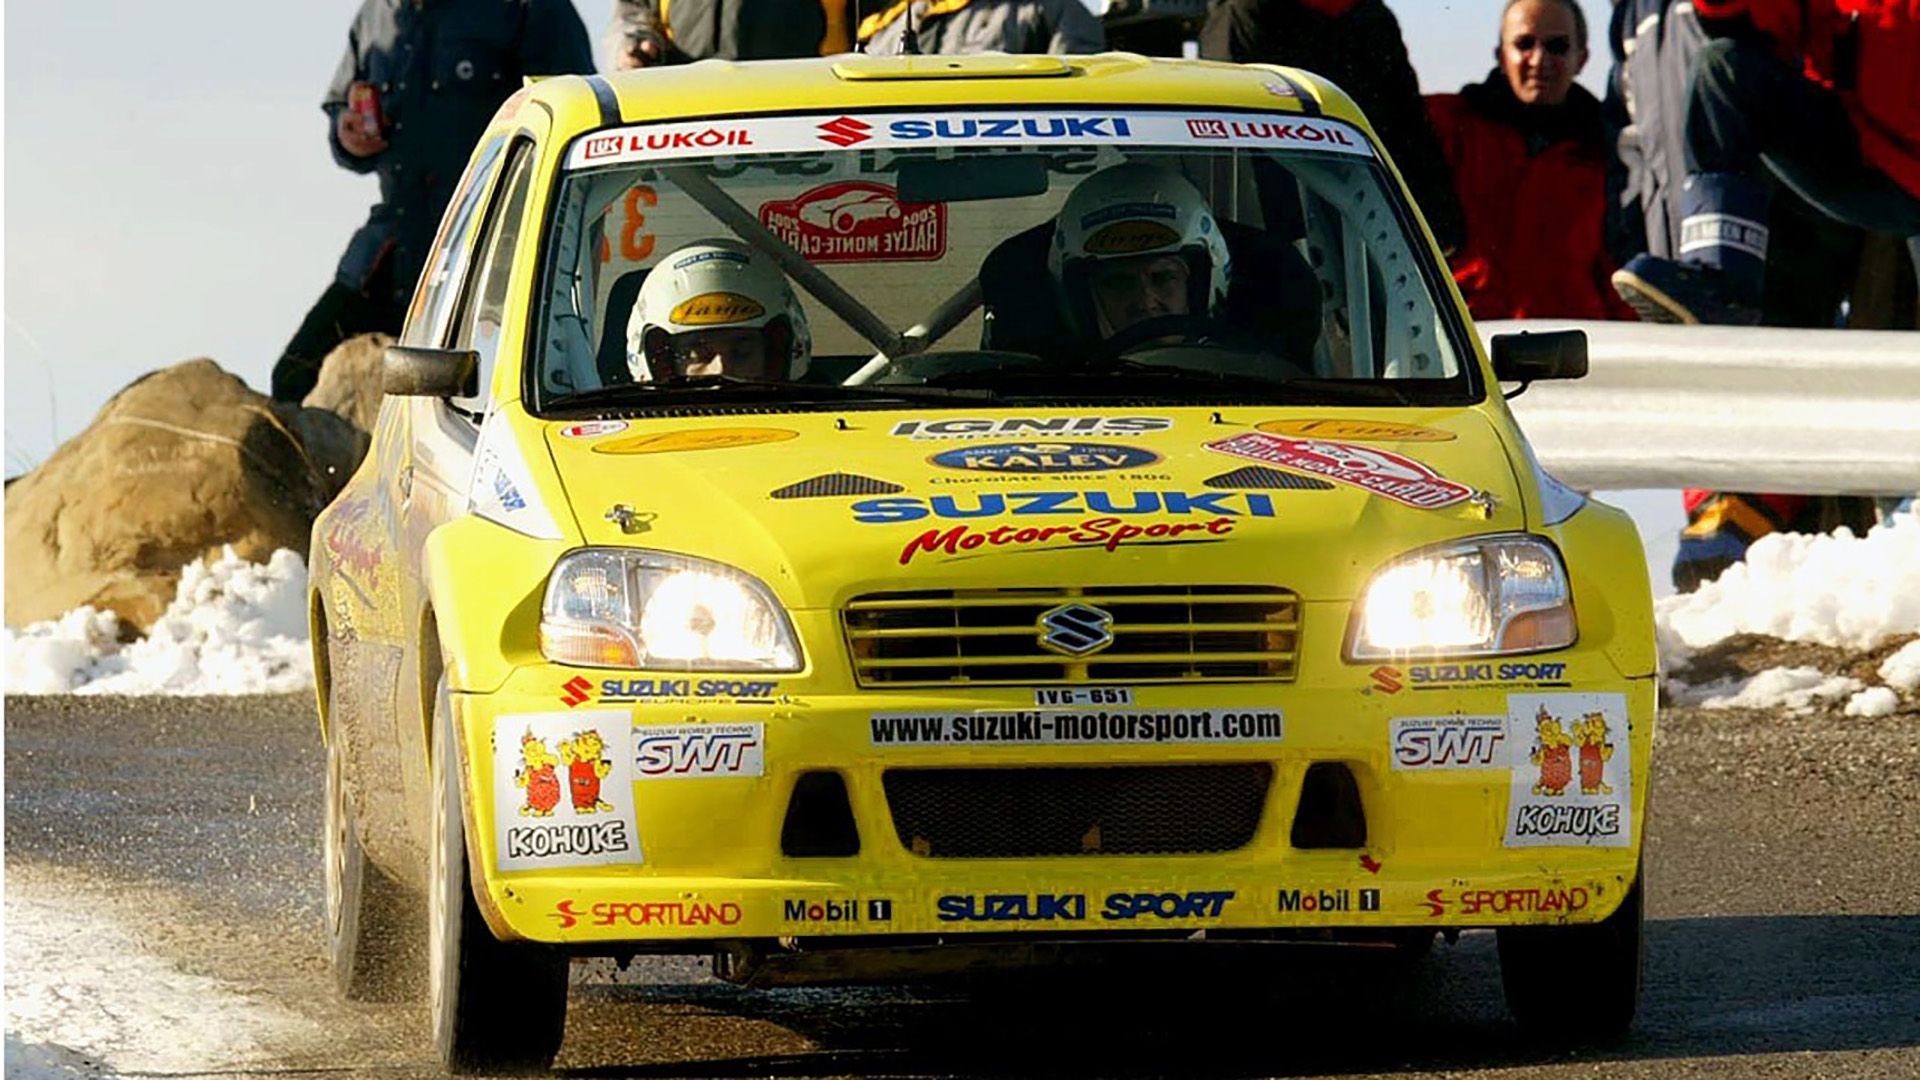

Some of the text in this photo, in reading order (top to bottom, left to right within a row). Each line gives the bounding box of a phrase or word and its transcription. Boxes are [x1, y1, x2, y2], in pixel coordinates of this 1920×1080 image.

[889, 118, 1131, 139] SUZUKI
[1186, 119, 1354, 146] LUK LUKOIL
[585, 128, 753, 159] LUK LUKOIL
[892, 418, 1170, 436] IGNIS
[964, 454, 1128, 469] KALEV
[929, 474, 1039, 484] Chocolate
[1050, 473, 1107, 481] since
[851, 492, 1276, 524] SUZUKI
[899, 518, 1237, 565] MotorSport
[1410, 663, 1567, 682] SUZUKI SPORT
[601, 679, 779, 698] SUZUKI SPORT
[1037, 689, 1128, 704] IVG-651
[870, 711, 1282, 743] www.suzuki-motorsport.com
[636, 734, 756, 775] SWT
[1395, 727, 1504, 766] SWT
[1516, 803, 1620, 837] KOHUKE
[508, 820, 629, 858] KOHUKE
[784, 899, 858, 922] Mobil
[937, 890, 1235, 921] SUZUKI SPORT
[1278, 888, 1350, 912] Mobil
[1460, 887, 1589, 914] SPORTLAND
[592, 901, 742, 927] SPORTLAND
